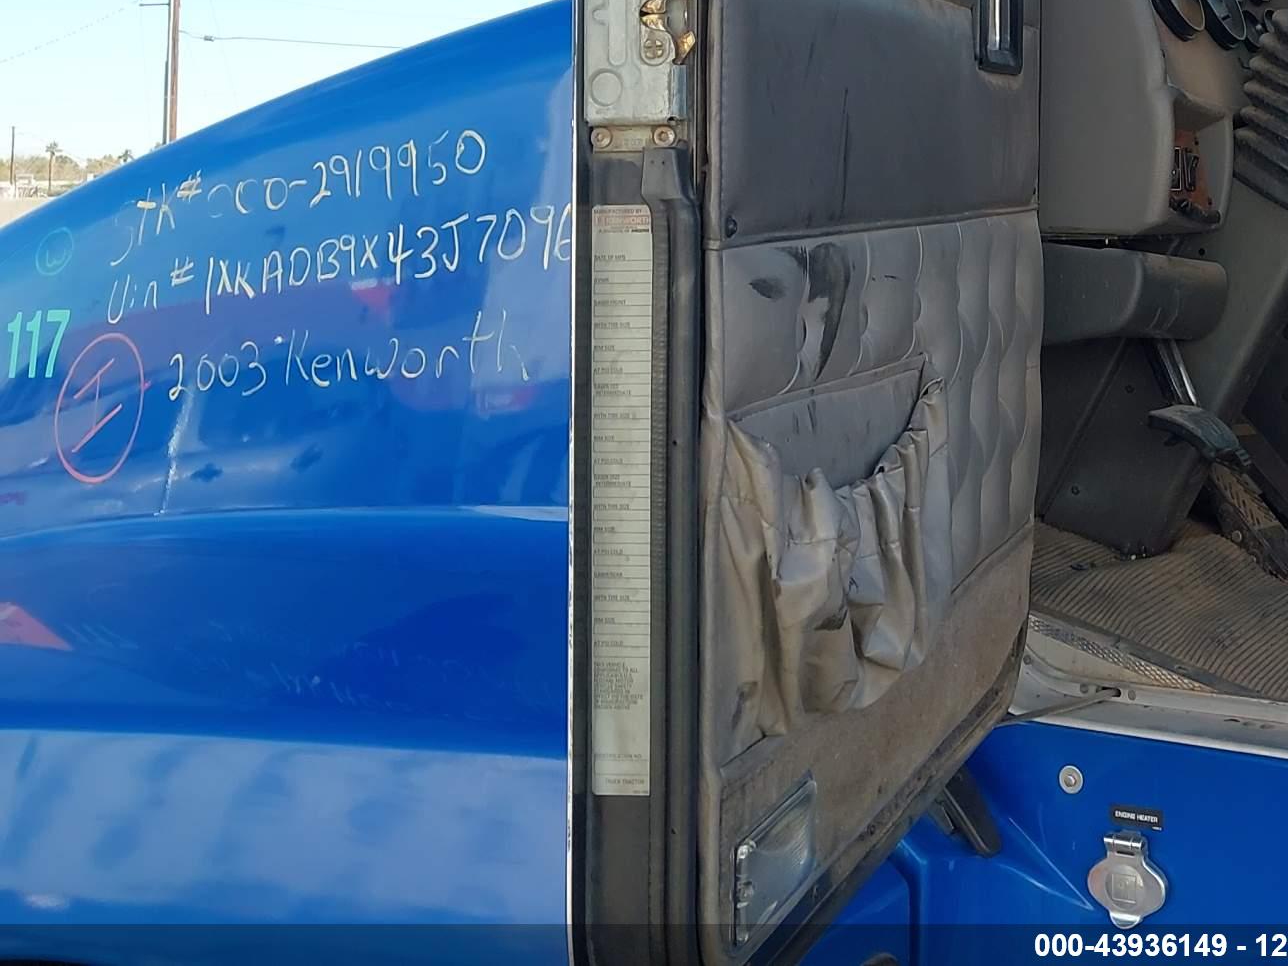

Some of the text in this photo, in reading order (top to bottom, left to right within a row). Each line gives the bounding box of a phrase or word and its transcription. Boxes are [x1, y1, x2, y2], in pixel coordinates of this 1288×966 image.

[8, 309, 71, 379] 117
[168, 341, 268, 401] 2003
[1136, 813, 1158, 823] HEATER
